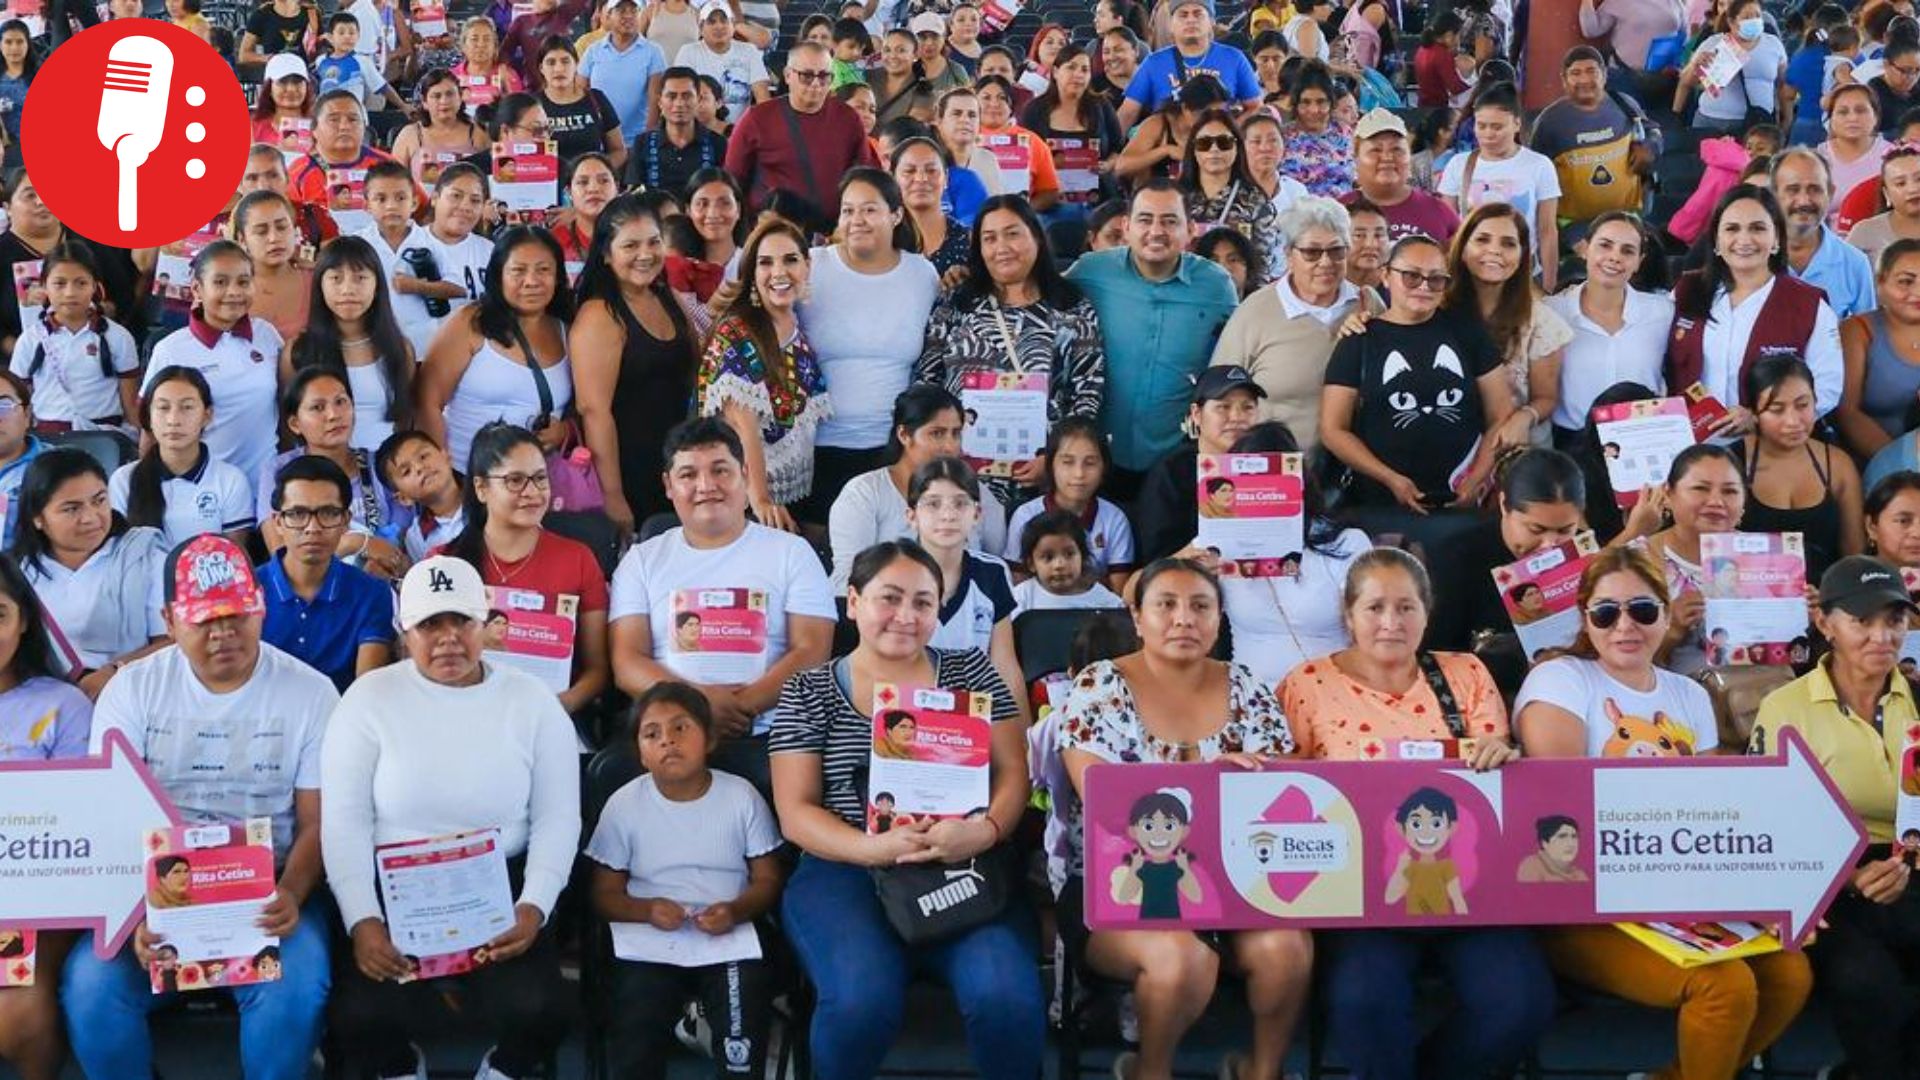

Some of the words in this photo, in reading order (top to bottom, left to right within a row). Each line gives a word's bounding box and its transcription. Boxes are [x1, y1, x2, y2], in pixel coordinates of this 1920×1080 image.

[428, 566, 453, 593] LA
[916, 730, 938, 744] Rita
[939, 733, 973, 747] Cetina
[1598, 809, 1673, 822] Educación
[1676, 808, 1740, 821] Primaria
[1283, 837, 1335, 852] Becas
[1599, 828, 1663, 856] Rita
[1670, 827, 1774, 855] Cetina
[27, 866, 94, 877] UNIFORMES
[97, 865, 103, 875] Y
[192, 871, 216, 884] Rita
[217, 867, 255, 881] Cetina
[1599, 863, 1626, 873] BECA
[1628, 862, 1642, 872] DE
[1644, 861, 1682, 872] APOYO
[1684, 862, 1712, 872] PARA
[1714, 861, 1777, 872] UNIFORMES
[1779, 861, 1786, 871] Y
[917, 876, 979, 918] PUMA
